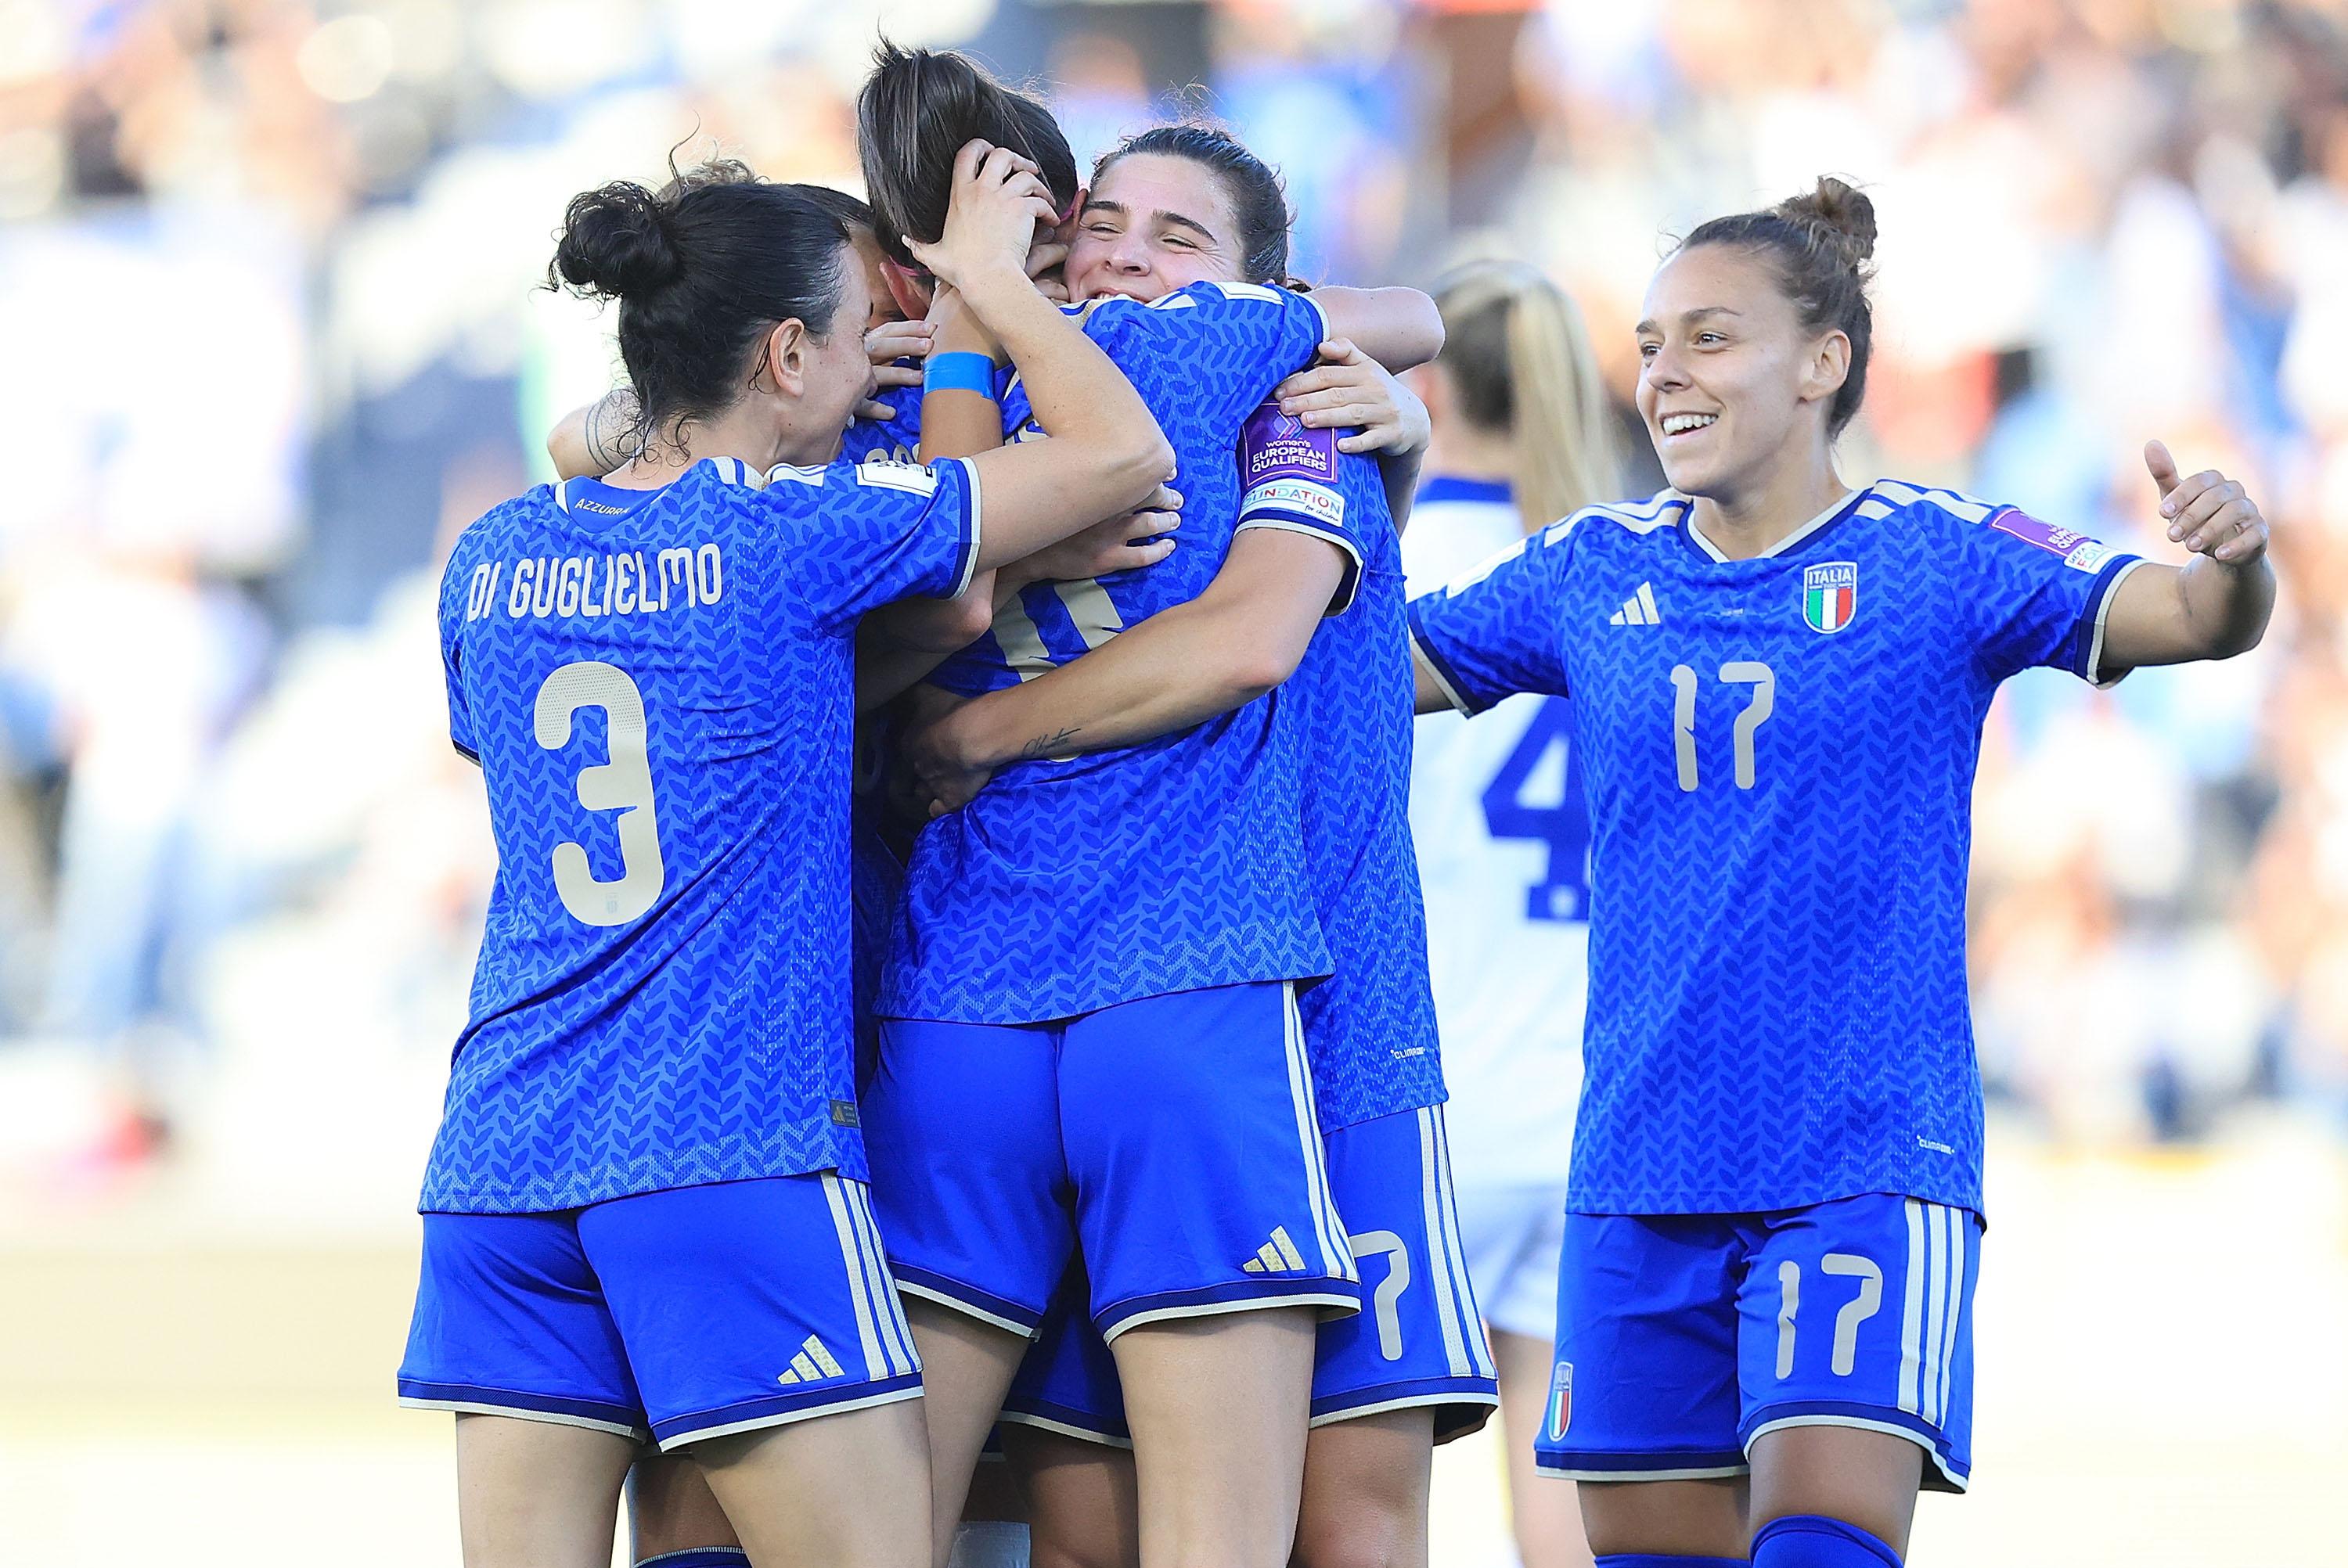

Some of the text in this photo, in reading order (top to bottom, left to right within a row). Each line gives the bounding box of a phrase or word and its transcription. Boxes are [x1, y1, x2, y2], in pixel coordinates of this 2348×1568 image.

[1251, 455, 1327, 473] QUALIFIERS
[1252, 447, 1327, 464] EUROPEAN
[1266, 440, 1312, 448] women's
[467, 542, 722, 623] DI GUGLIELMO
[1809, 567, 1853, 586] ITALIA
[1669, 661, 1776, 793] 17
[534, 660, 665, 927] 3
[1482, 694, 1592, 919] 4
[1774, 1253, 1884, 1380] 17
